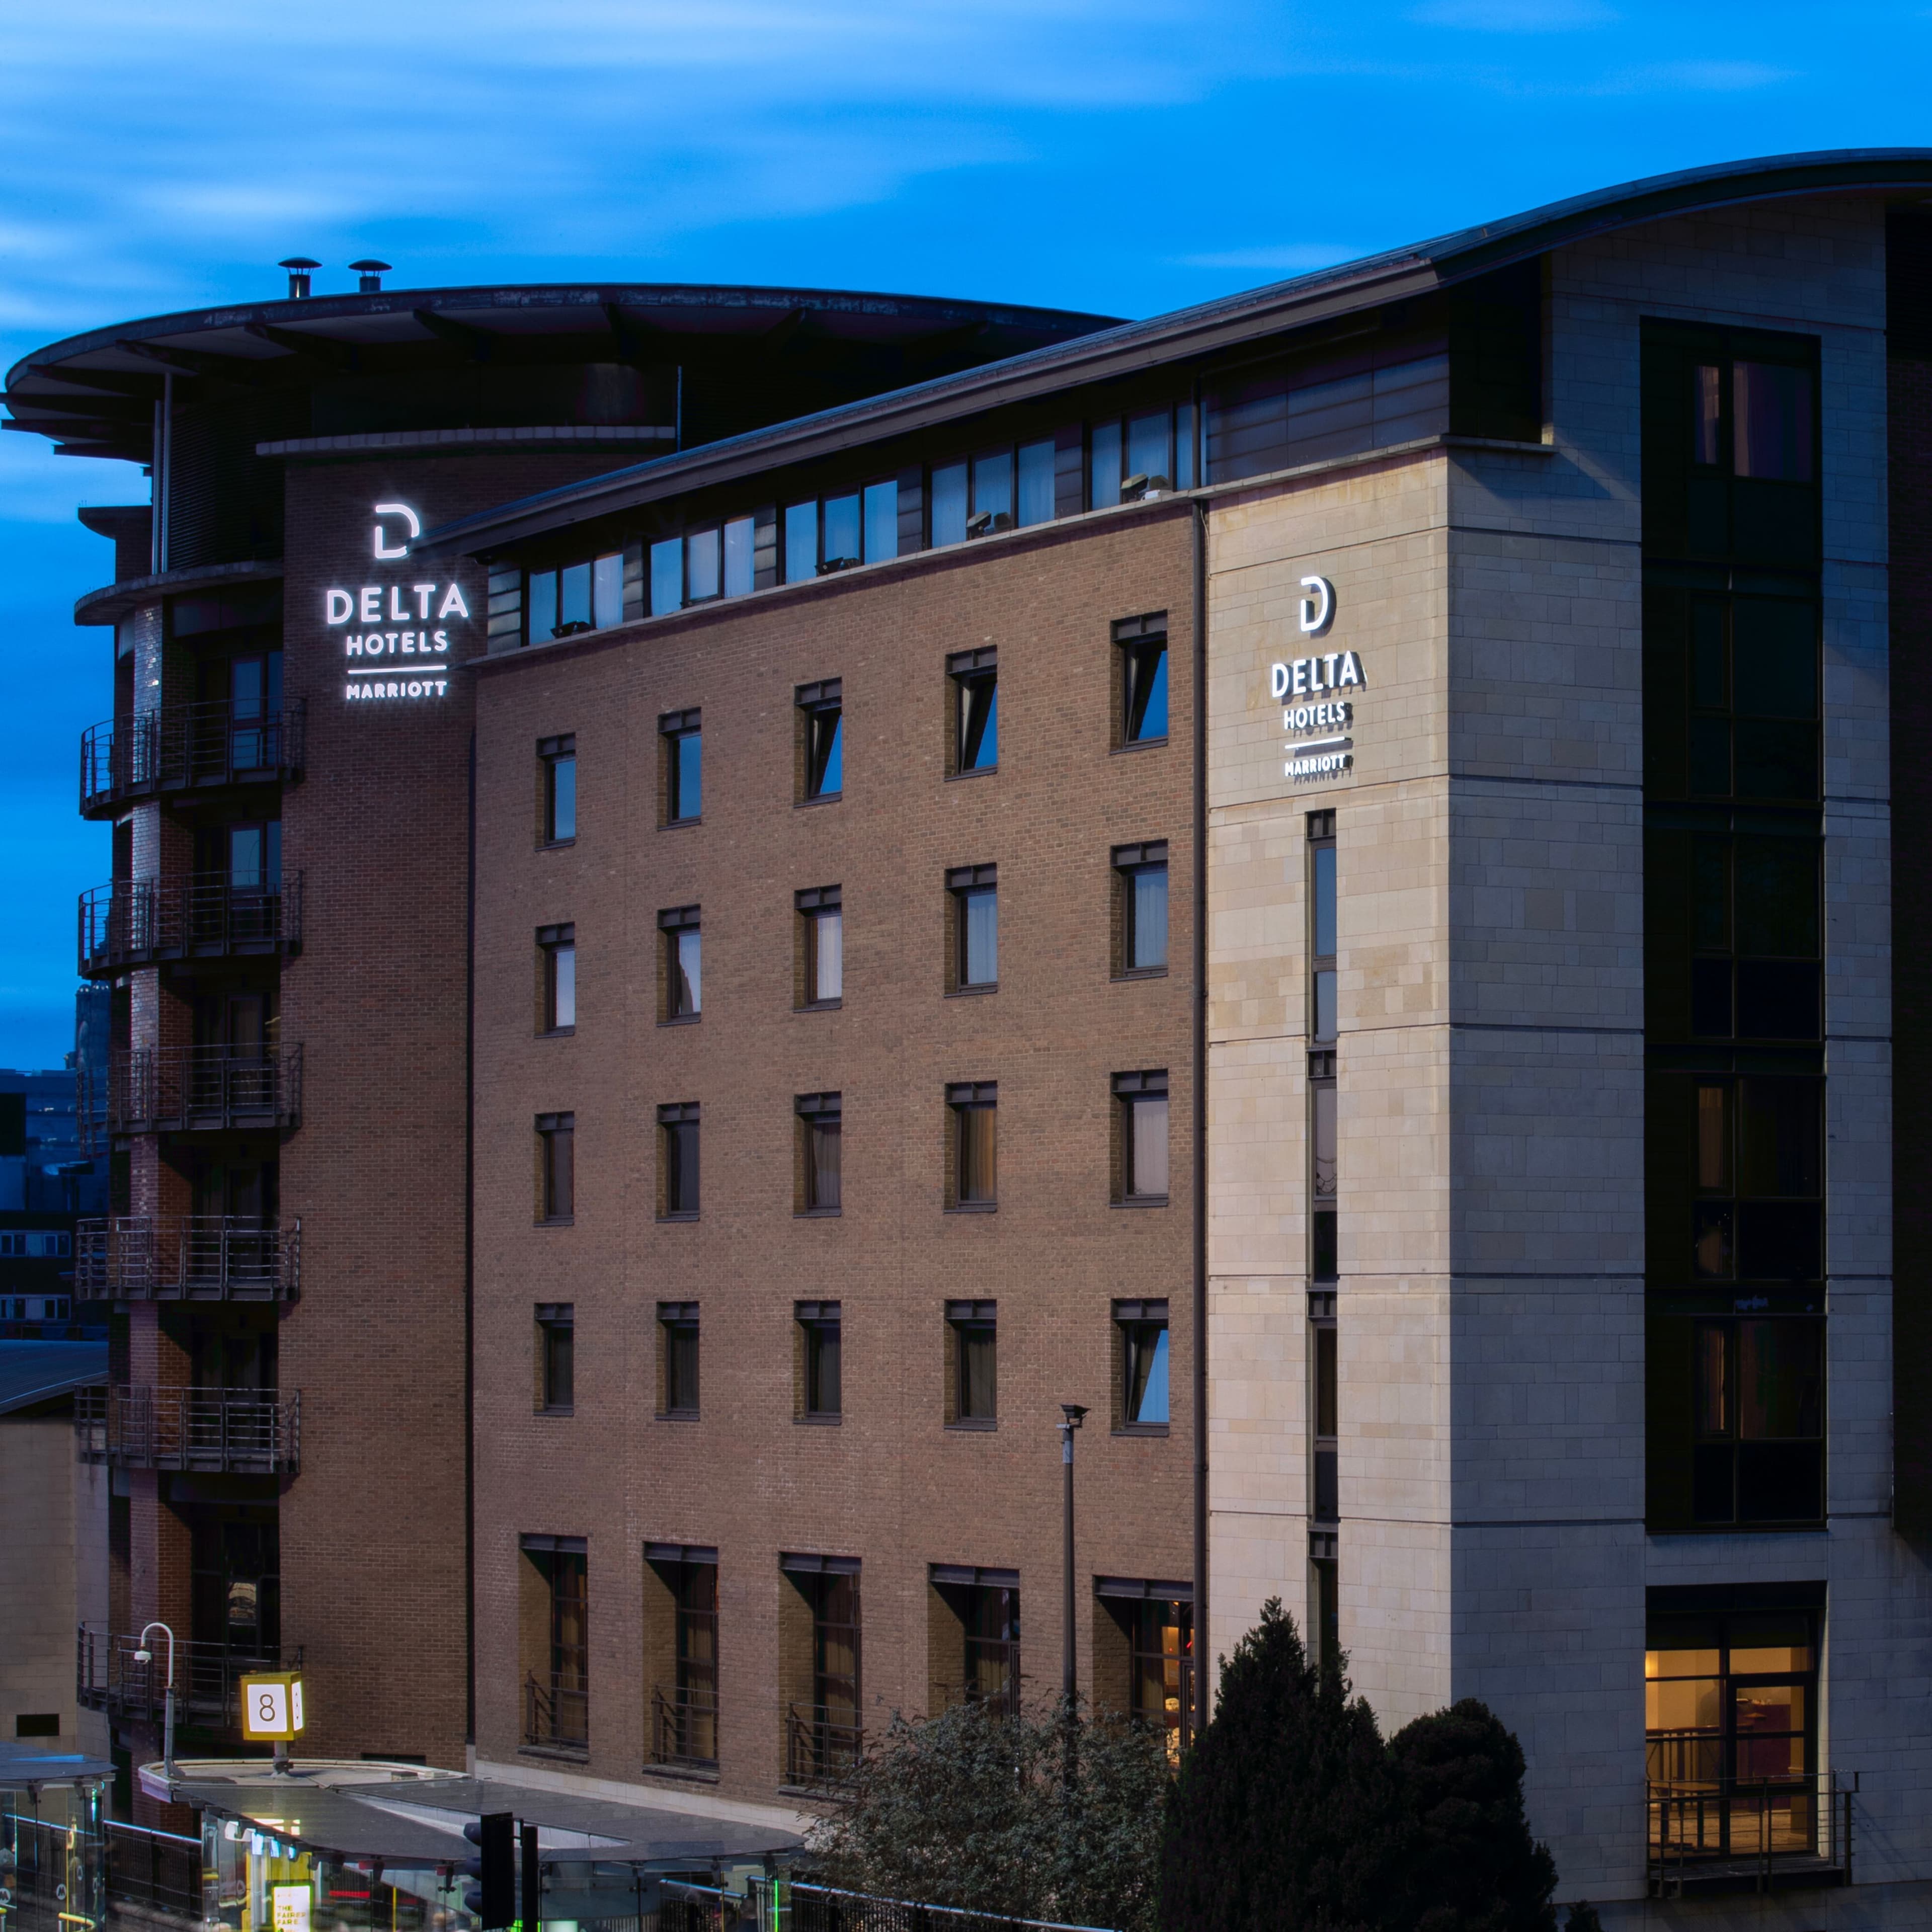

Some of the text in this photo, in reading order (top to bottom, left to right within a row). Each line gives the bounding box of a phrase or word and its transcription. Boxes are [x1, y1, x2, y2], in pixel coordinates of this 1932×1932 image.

[327, 583, 468, 624] DELTA
[346, 631, 448, 656] HOTELS
[1272, 650, 1358, 698] DELTA
[346, 681, 448, 699] MARRIOTT
[1283, 701, 1346, 730] HOTELS
[1284, 754, 1346, 777] MARRIOTT
[259, 1694, 276, 1722] 8
